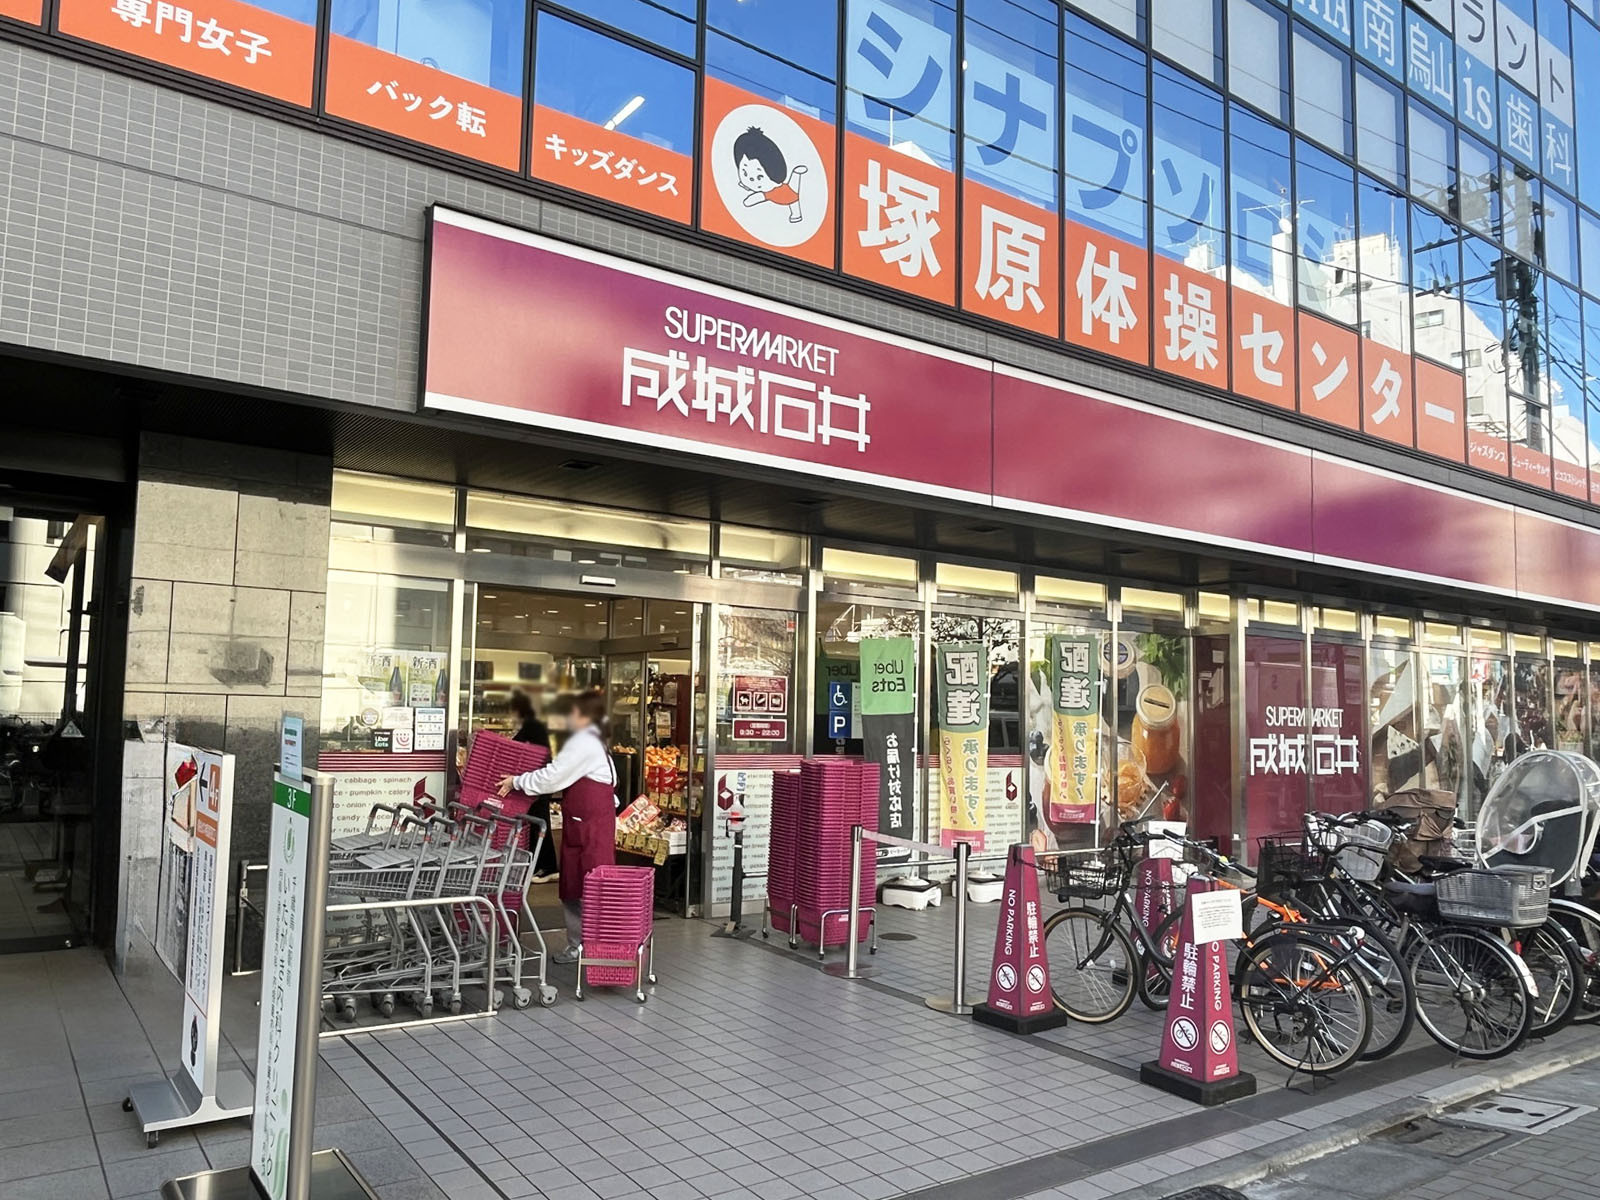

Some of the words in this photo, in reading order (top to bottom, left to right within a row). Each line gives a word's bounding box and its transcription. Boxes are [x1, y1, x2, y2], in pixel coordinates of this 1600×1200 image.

[1424, 0, 1565, 103] ラント
[366, 79, 487, 138] バック転
[544, 133, 679, 197] キッズダンス
[664, 306, 840, 377] SUPERMARKET
[621, 346, 871, 453] 成城石井
[834, 716, 846, 733] P
[1250, 733, 1359, 776] 成城石井
[286, 788, 297, 809] 3F
[344, 776, 377, 784] cabbage
[383, 776, 412, 785] spinach
[349, 789, 383, 797] pumpkin
[336, 814, 361, 822] candy
[1008, 889, 1017, 908] NO
[1004, 908, 1015, 957] PARKING
[1026, 901, 1040, 958] 駐輪禁止
[1211, 941, 1220, 953] O
[1180, 942, 1199, 1011] 駐輪禁止
[1211, 955, 1222, 1012] PARKING
